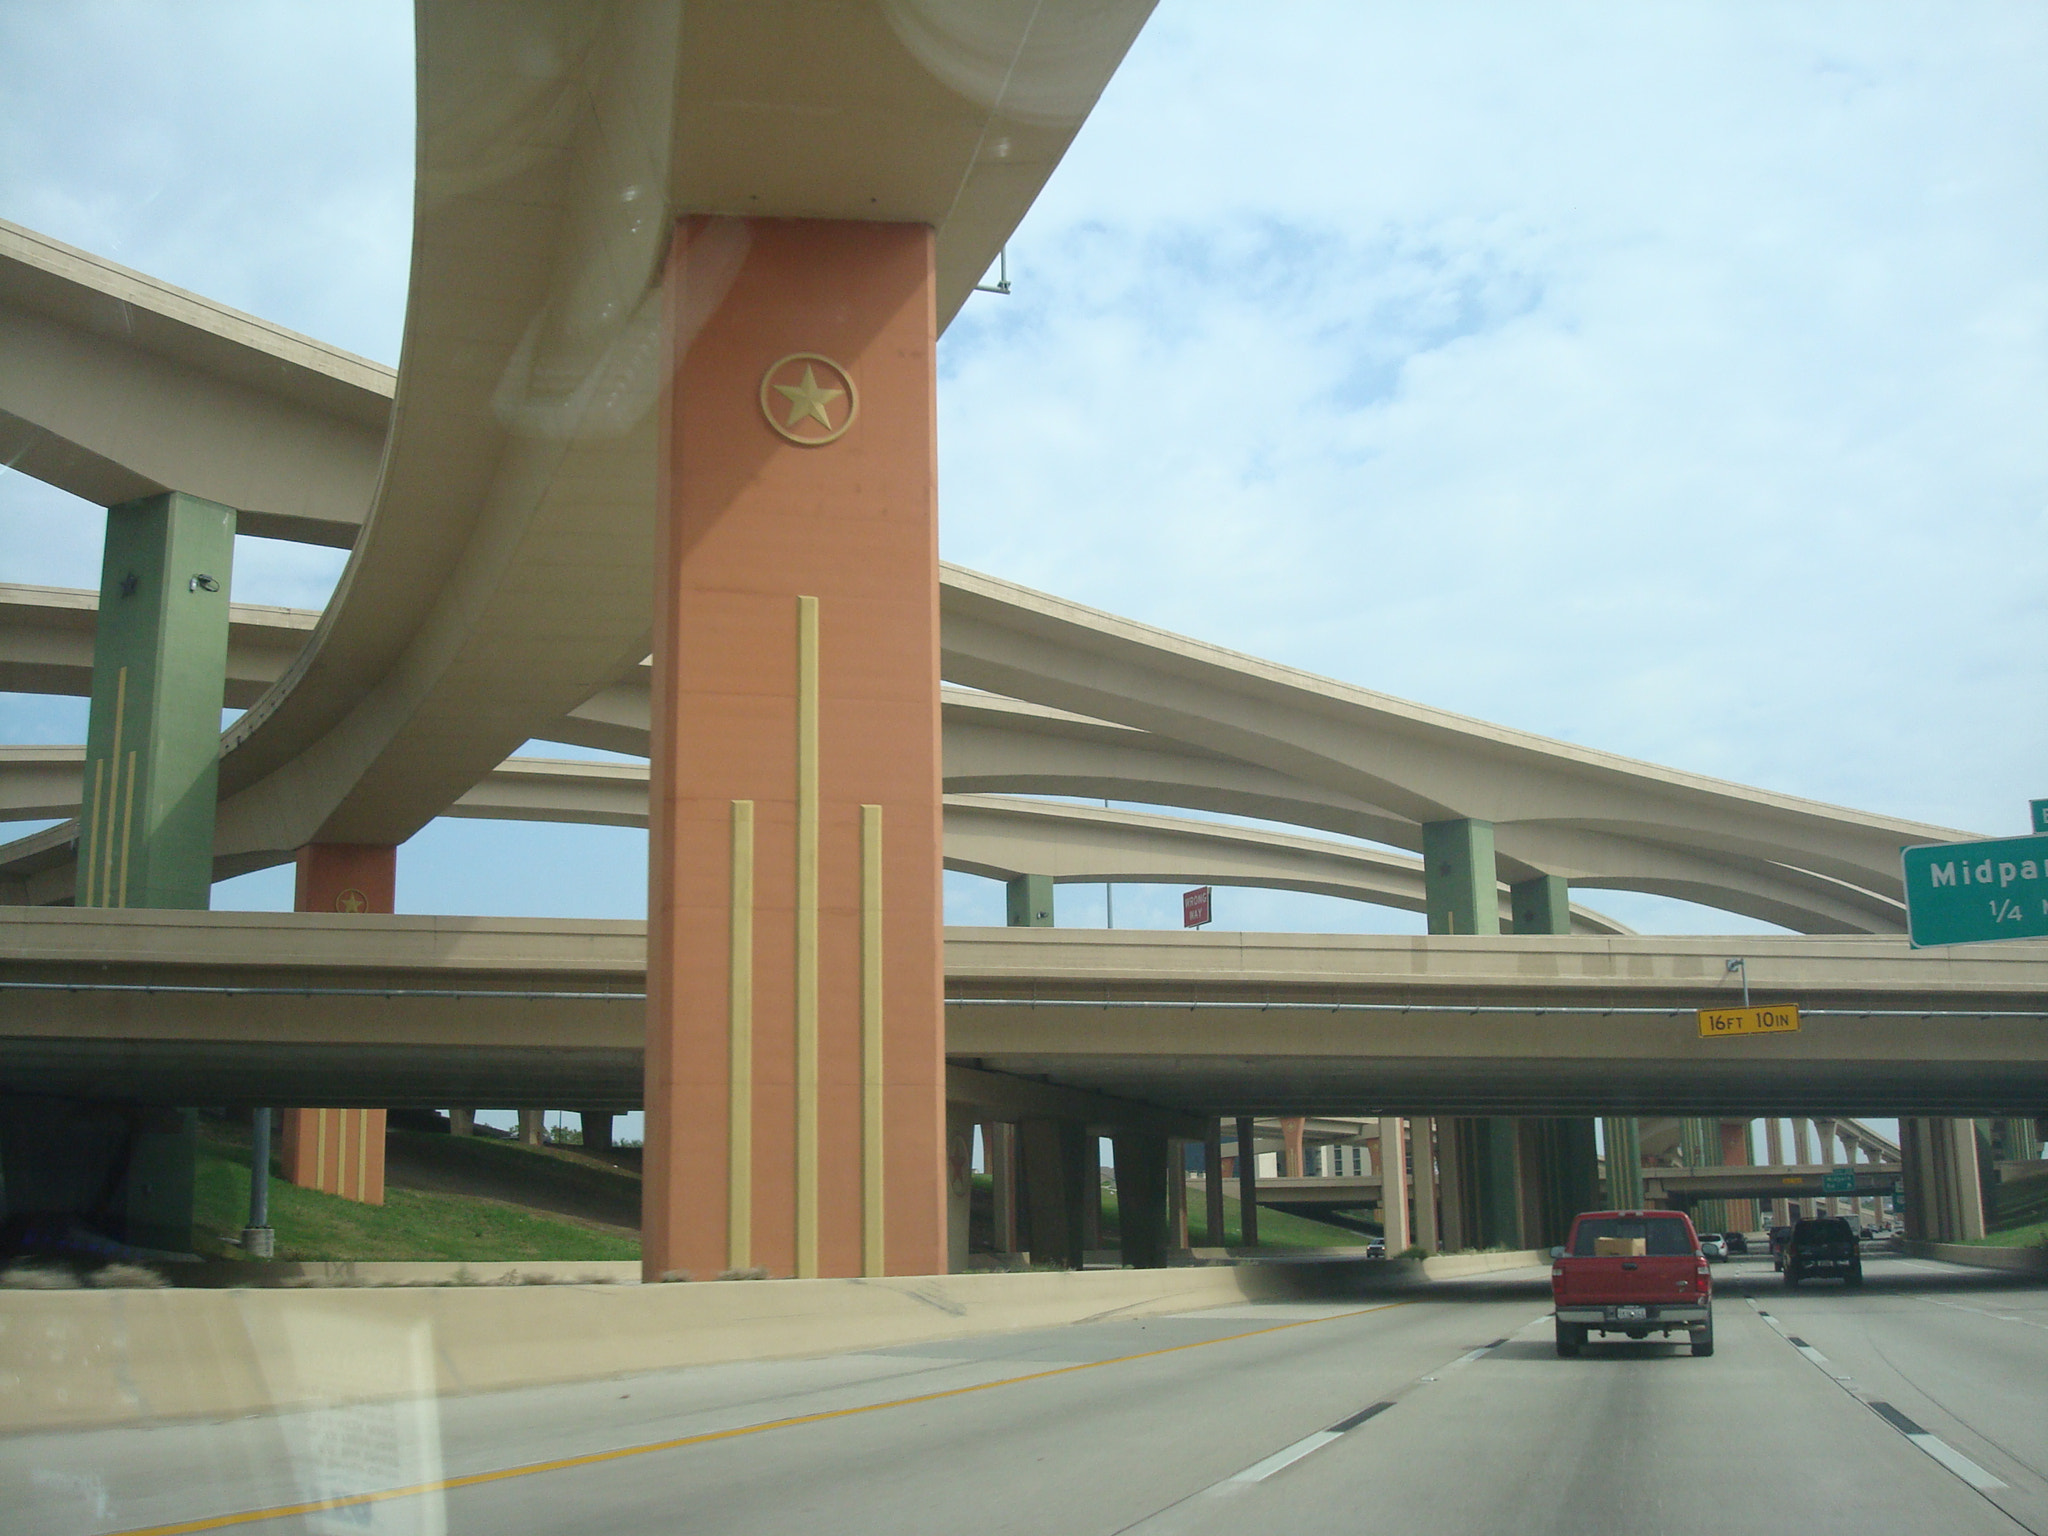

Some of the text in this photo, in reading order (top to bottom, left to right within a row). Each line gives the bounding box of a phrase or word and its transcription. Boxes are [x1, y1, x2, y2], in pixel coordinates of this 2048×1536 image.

[1185, 892, 1207, 908] WRONG
[1189, 907, 1203, 921] WAY
[1709, 1012, 1789, 1031] 16FT 10IN
